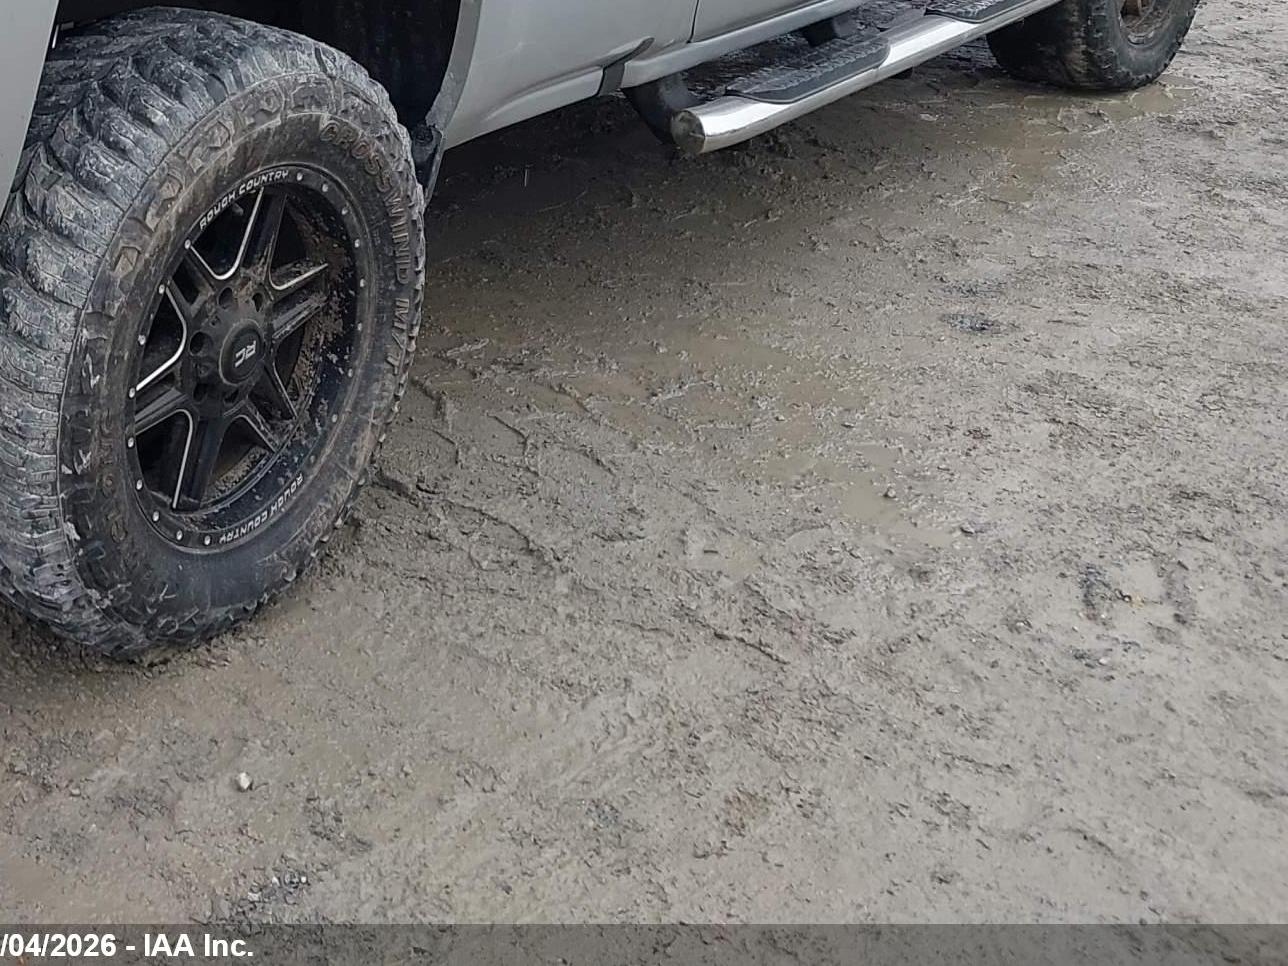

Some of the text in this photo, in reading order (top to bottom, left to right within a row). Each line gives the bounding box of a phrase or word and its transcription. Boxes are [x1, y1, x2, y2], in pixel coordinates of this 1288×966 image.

[199, 169, 289, 231] ROUGH COUNTRY
[319, 120, 410, 285] CROSSWIND
[234, 339, 257, 368] RC
[219, 473, 304, 545] ROUGH COUNTRY
